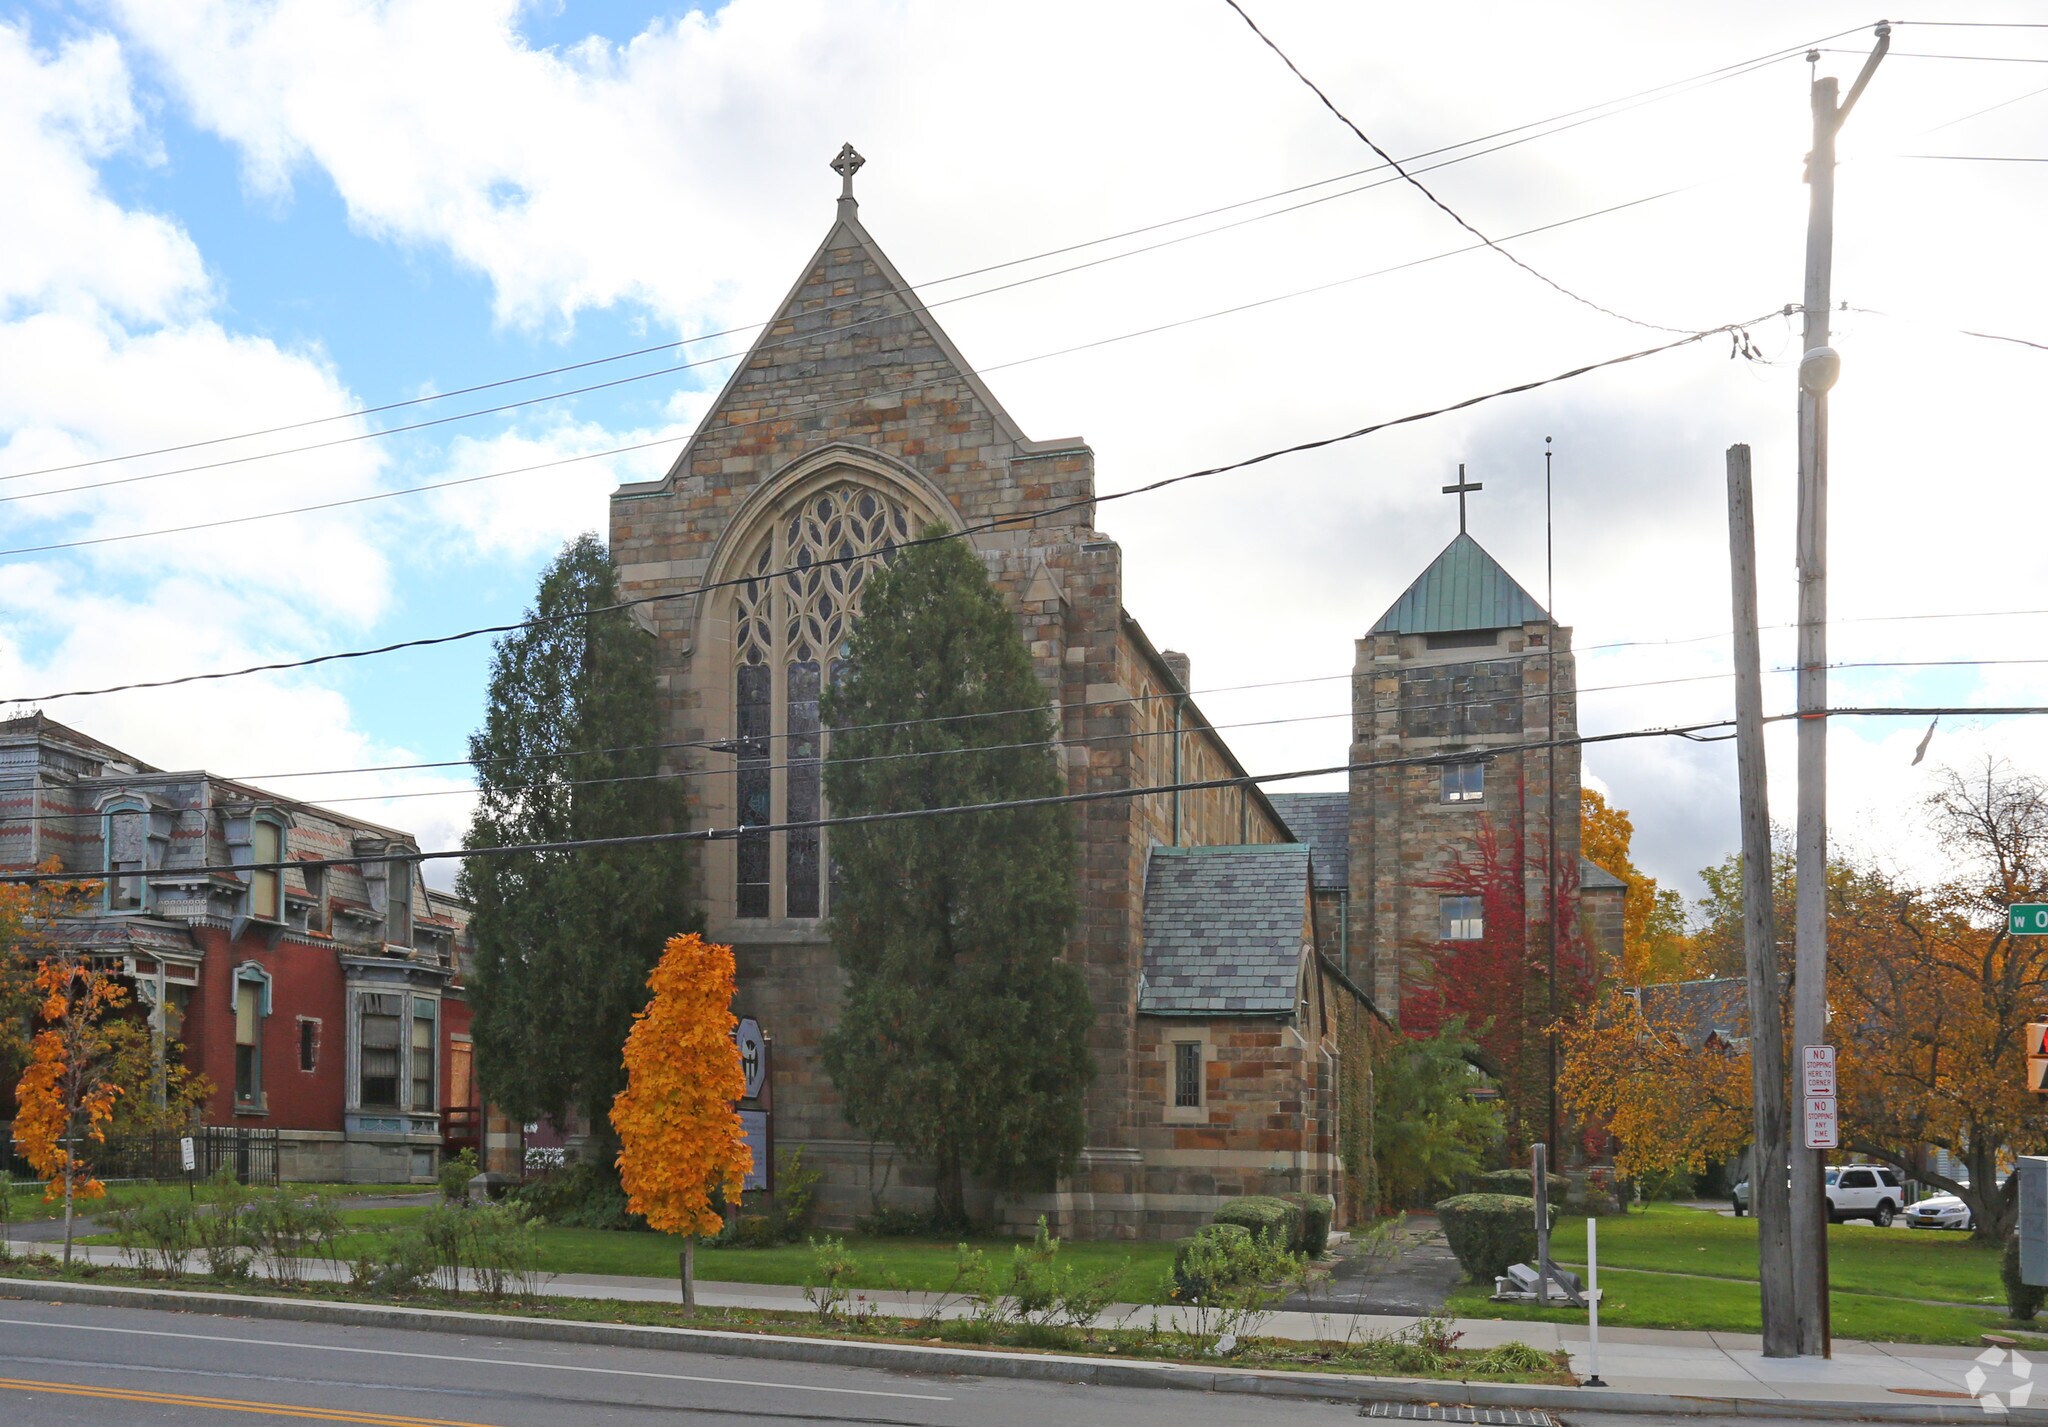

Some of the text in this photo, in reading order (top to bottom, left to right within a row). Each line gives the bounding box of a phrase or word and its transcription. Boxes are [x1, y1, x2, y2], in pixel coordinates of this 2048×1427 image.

[2014, 916, 2025, 928] W
[1813, 1050, 1825, 1060] NO
[1807, 1061, 1832, 1069] STOPPING
[1814, 1101, 1826, 1111] NO
[1808, 1112, 1833, 1120] STOPPING
